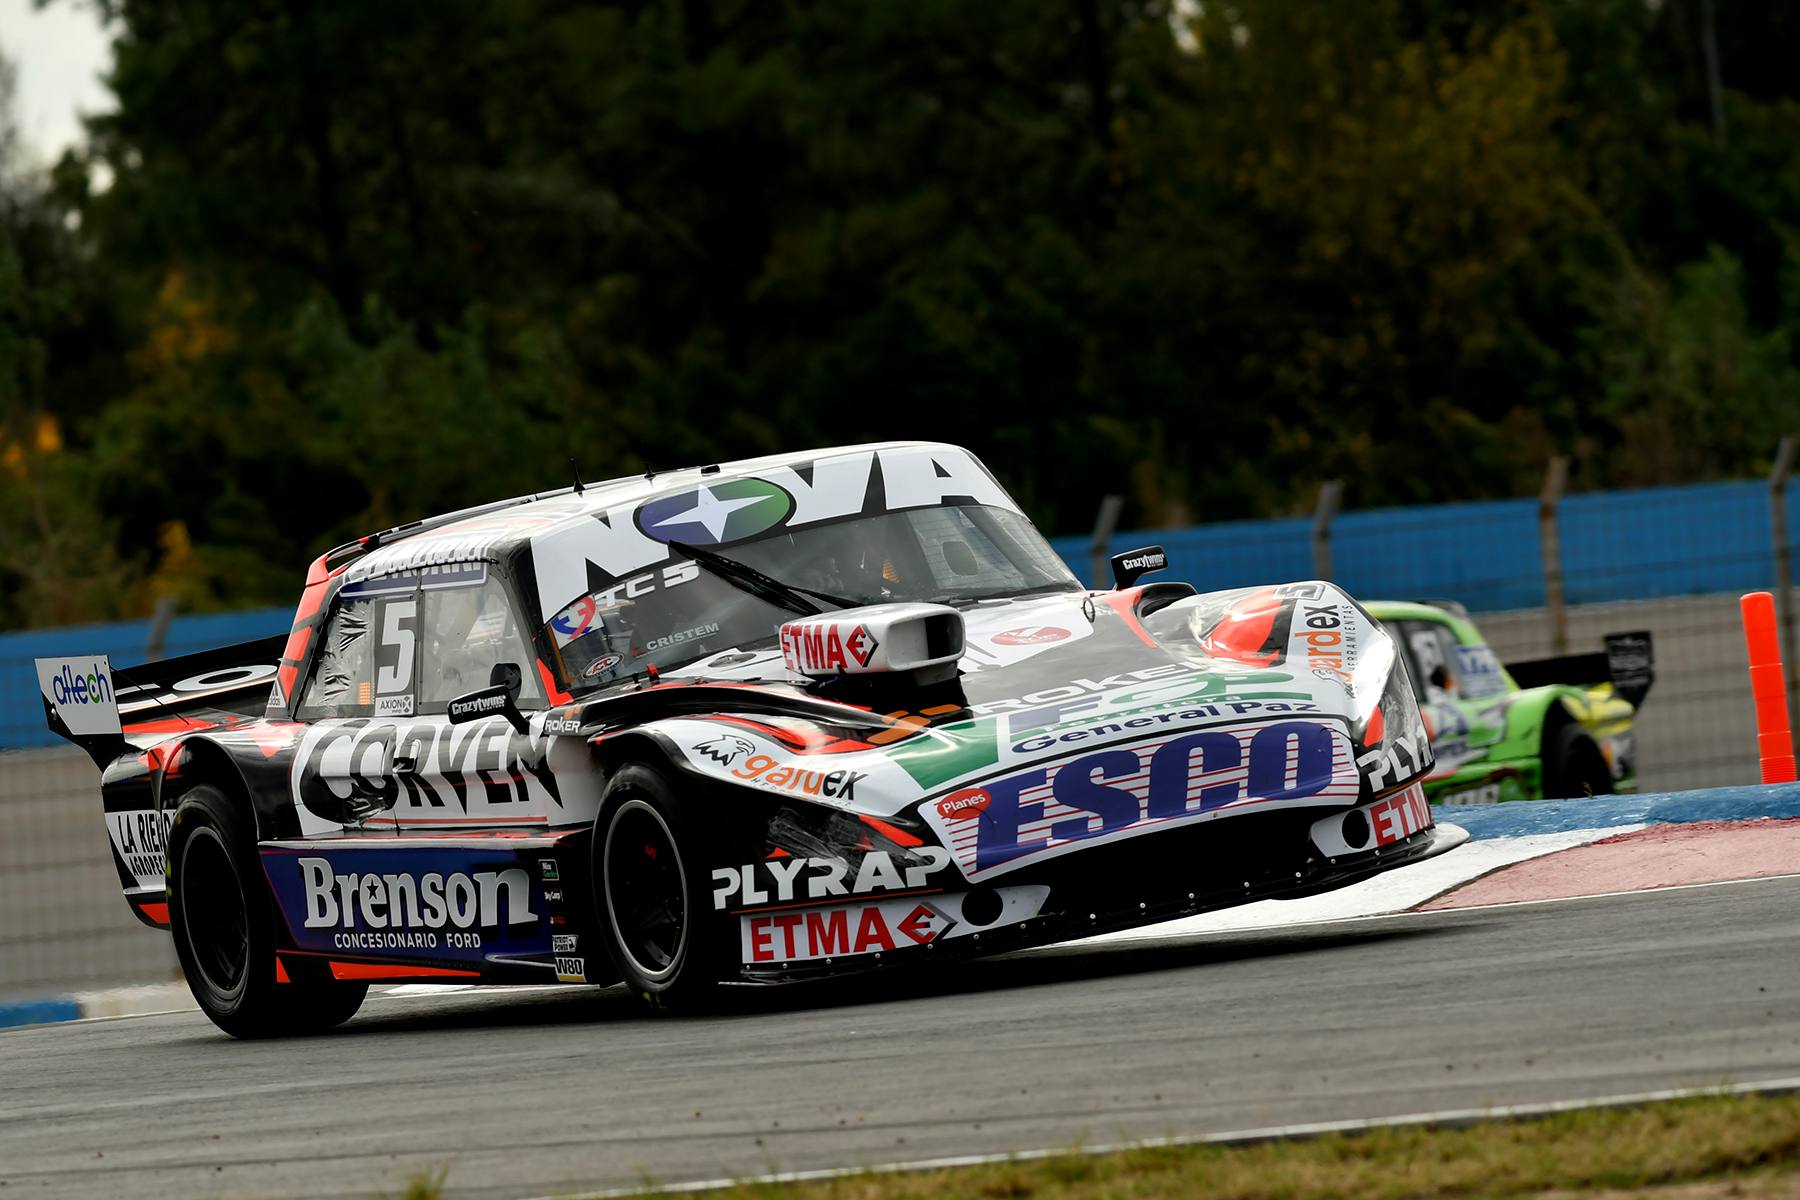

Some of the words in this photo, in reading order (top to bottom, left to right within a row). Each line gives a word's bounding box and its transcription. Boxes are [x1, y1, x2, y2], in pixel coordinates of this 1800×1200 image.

[376, 600, 417, 694] 5
[646, 622, 720, 651] CRISTEM
[781, 624, 849, 670] ETMA
[380, 699, 403, 710] AXION
[452, 694, 506, 715] Crazytwins
[545, 717, 581, 733] ROKER
[1011, 704, 1221, 753] General
[1225, 701, 1321, 714] Paz
[299, 719, 564, 825] CORVEN
[943, 790, 986, 815] Planes
[975, 721, 1334, 871] ESCO
[117, 814, 138, 854] LA
[298, 857, 539, 929] Brenson
[711, 845, 951, 910] PLYRAP
[334, 932, 437, 949] CONCESIONARIO
[446, 932, 481, 949] FORD
[750, 906, 897, 962] ETMA
[555, 958, 583, 975] W80
